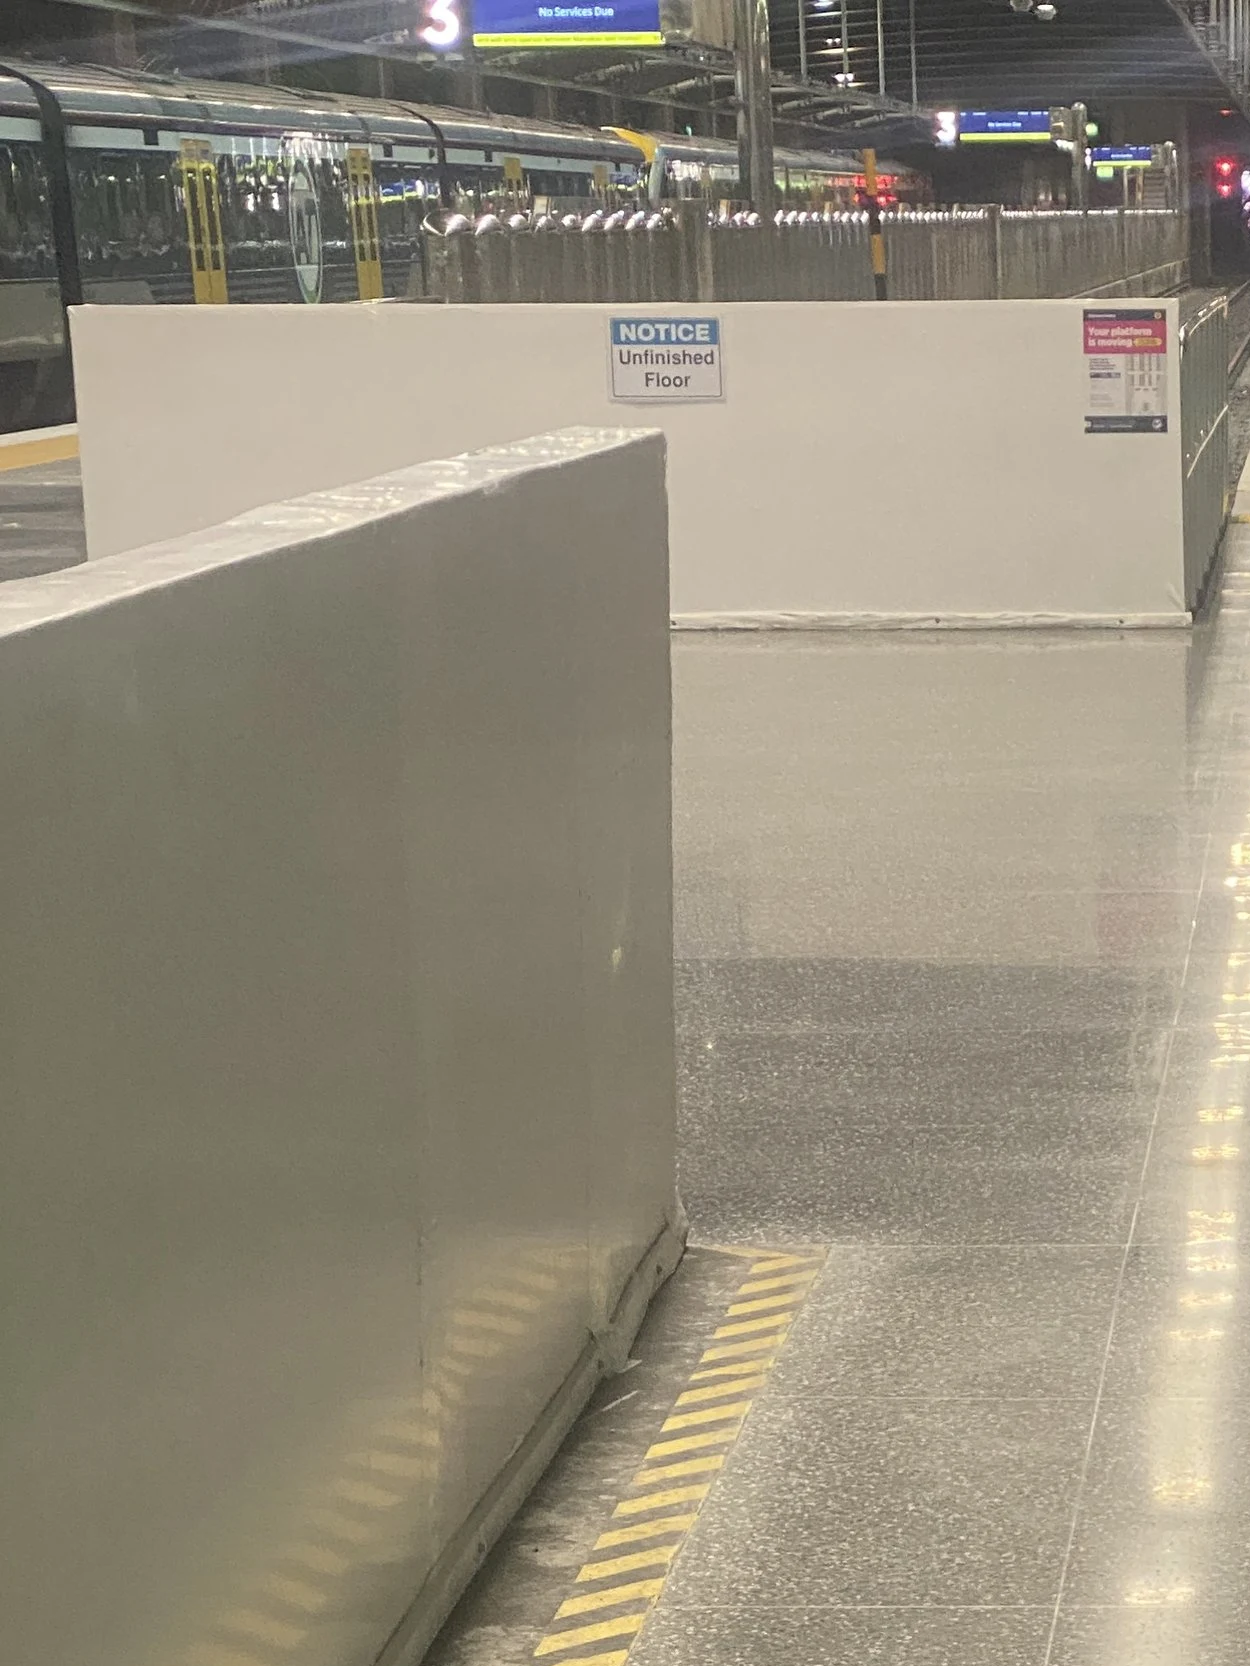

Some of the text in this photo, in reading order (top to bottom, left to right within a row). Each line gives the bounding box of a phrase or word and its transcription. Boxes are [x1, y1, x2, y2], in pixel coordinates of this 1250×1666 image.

[538, 6, 614, 16] No Services Due
[620, 323, 710, 342] NOTICE
[1088, 327, 1152, 337] Your platform
[1097, 338, 1132, 347] moving
[619, 349, 714, 365] Unfinished
[644, 372, 691, 387] Floor
